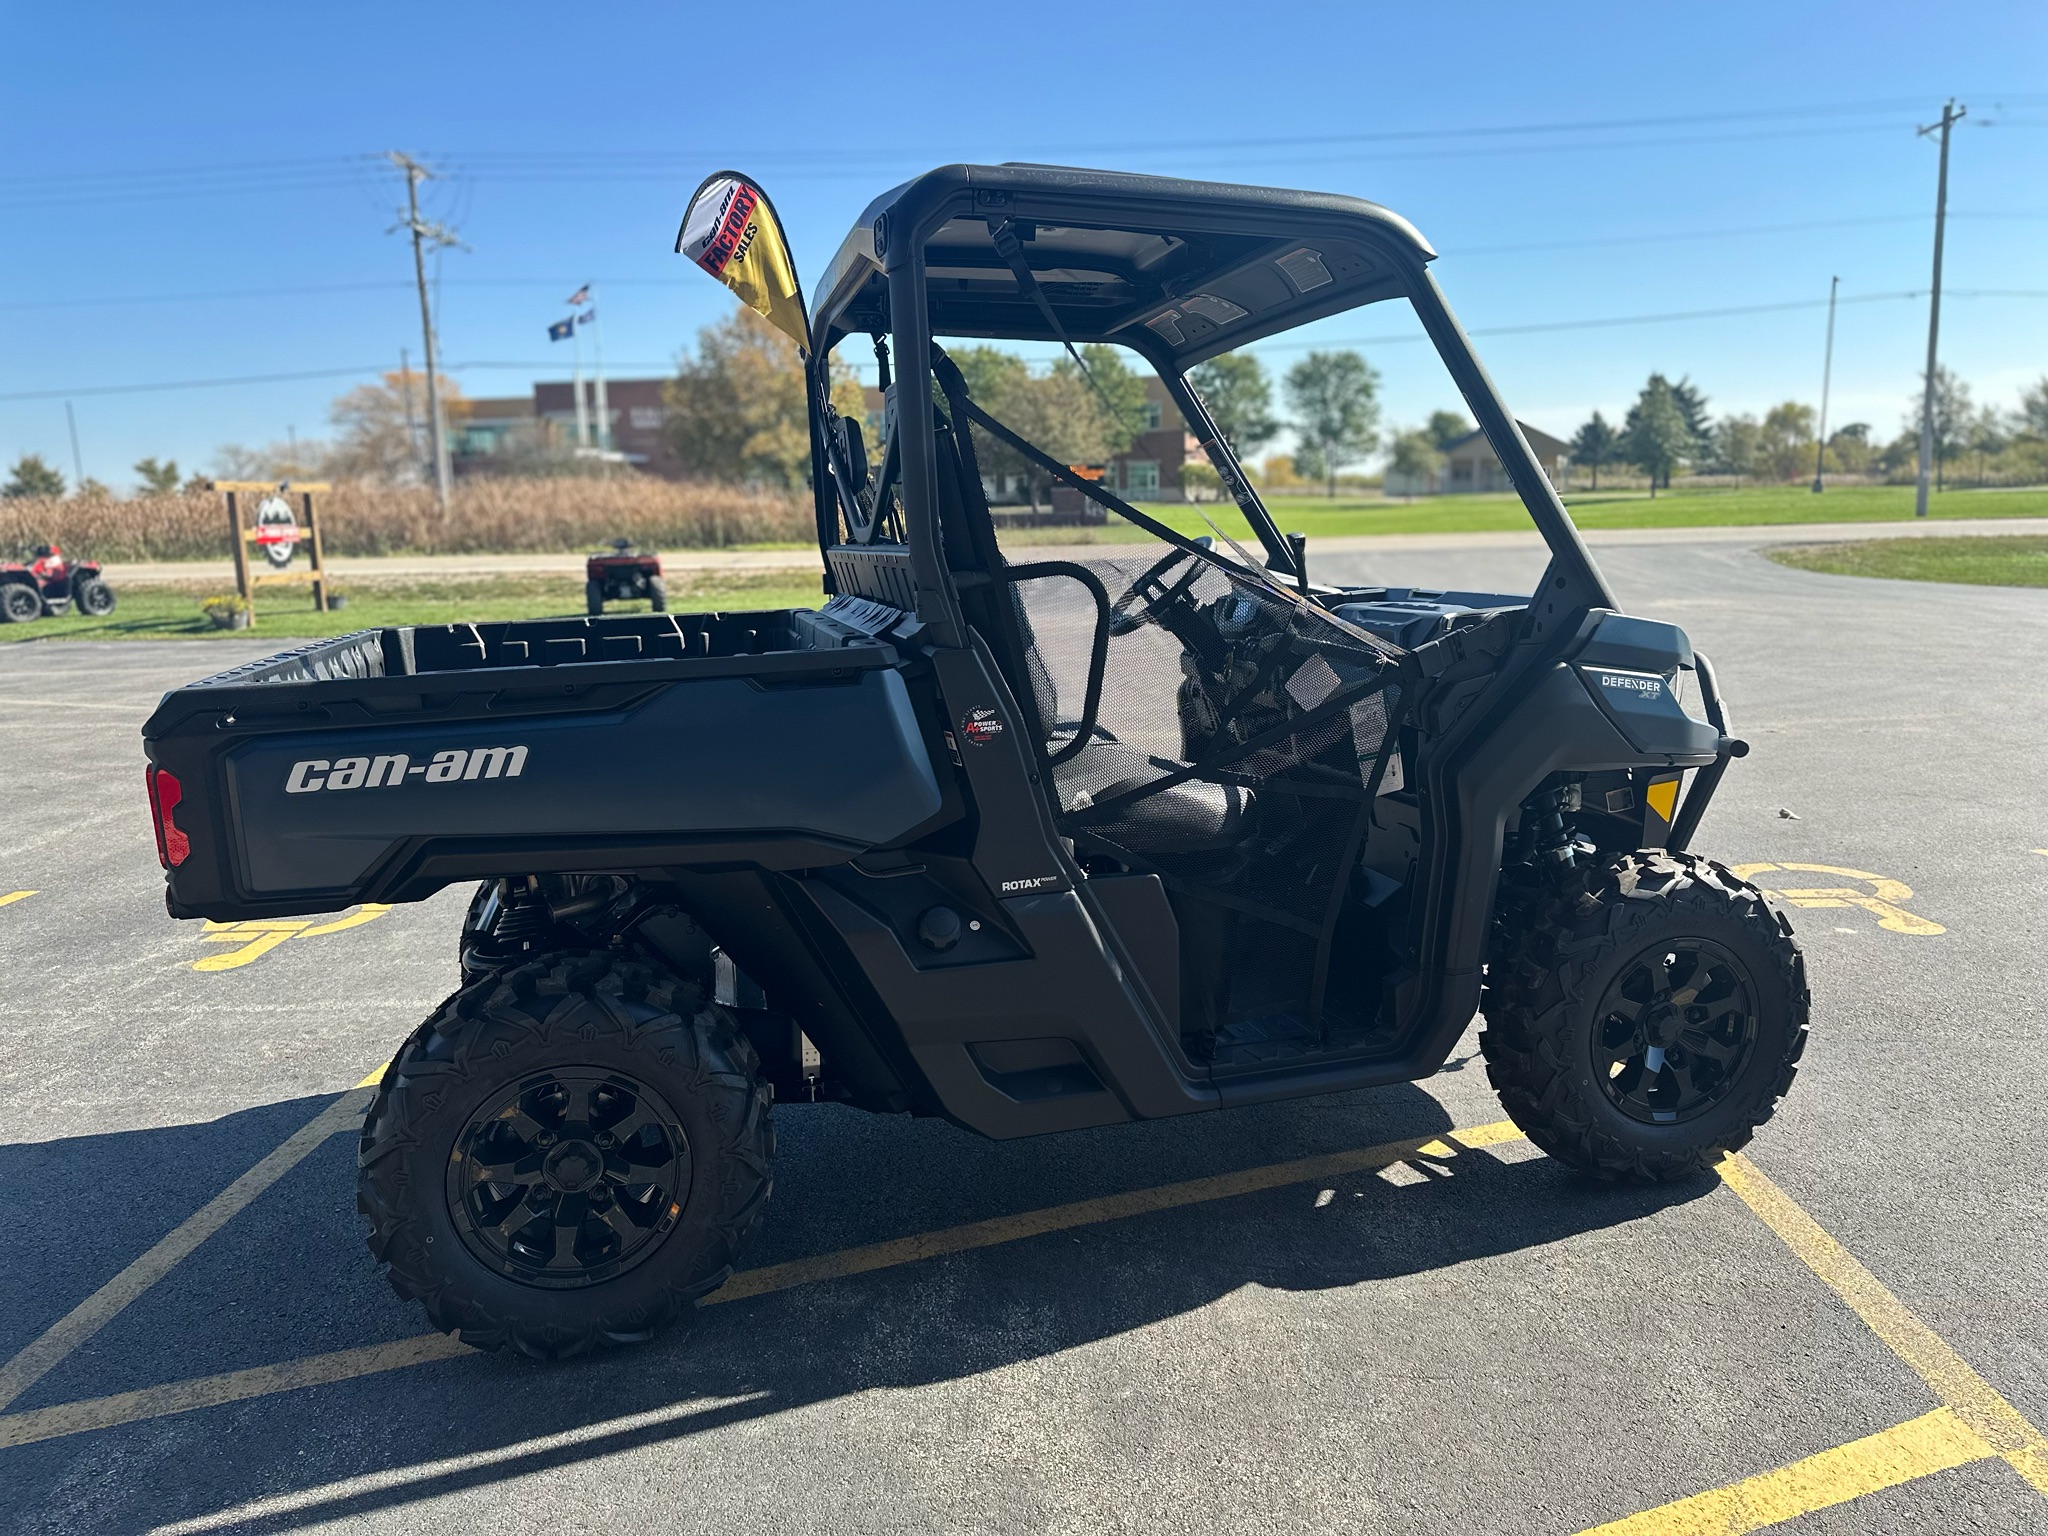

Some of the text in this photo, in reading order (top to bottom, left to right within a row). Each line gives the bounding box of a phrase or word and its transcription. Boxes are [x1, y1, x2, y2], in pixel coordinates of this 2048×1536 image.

[702, 186, 735, 249] can-am
[704, 183, 758, 272] FACTORY
[733, 221, 758, 263] SALES
[1602, 676, 1661, 692] DEFENDER
[1638, 690, 1661, 700] XT
[973, 720, 997, 728] POWER
[979, 724, 1003, 732] SPORTS
[285, 745, 530, 794] can-am
[1001, 877, 1041, 892] ROTAX
